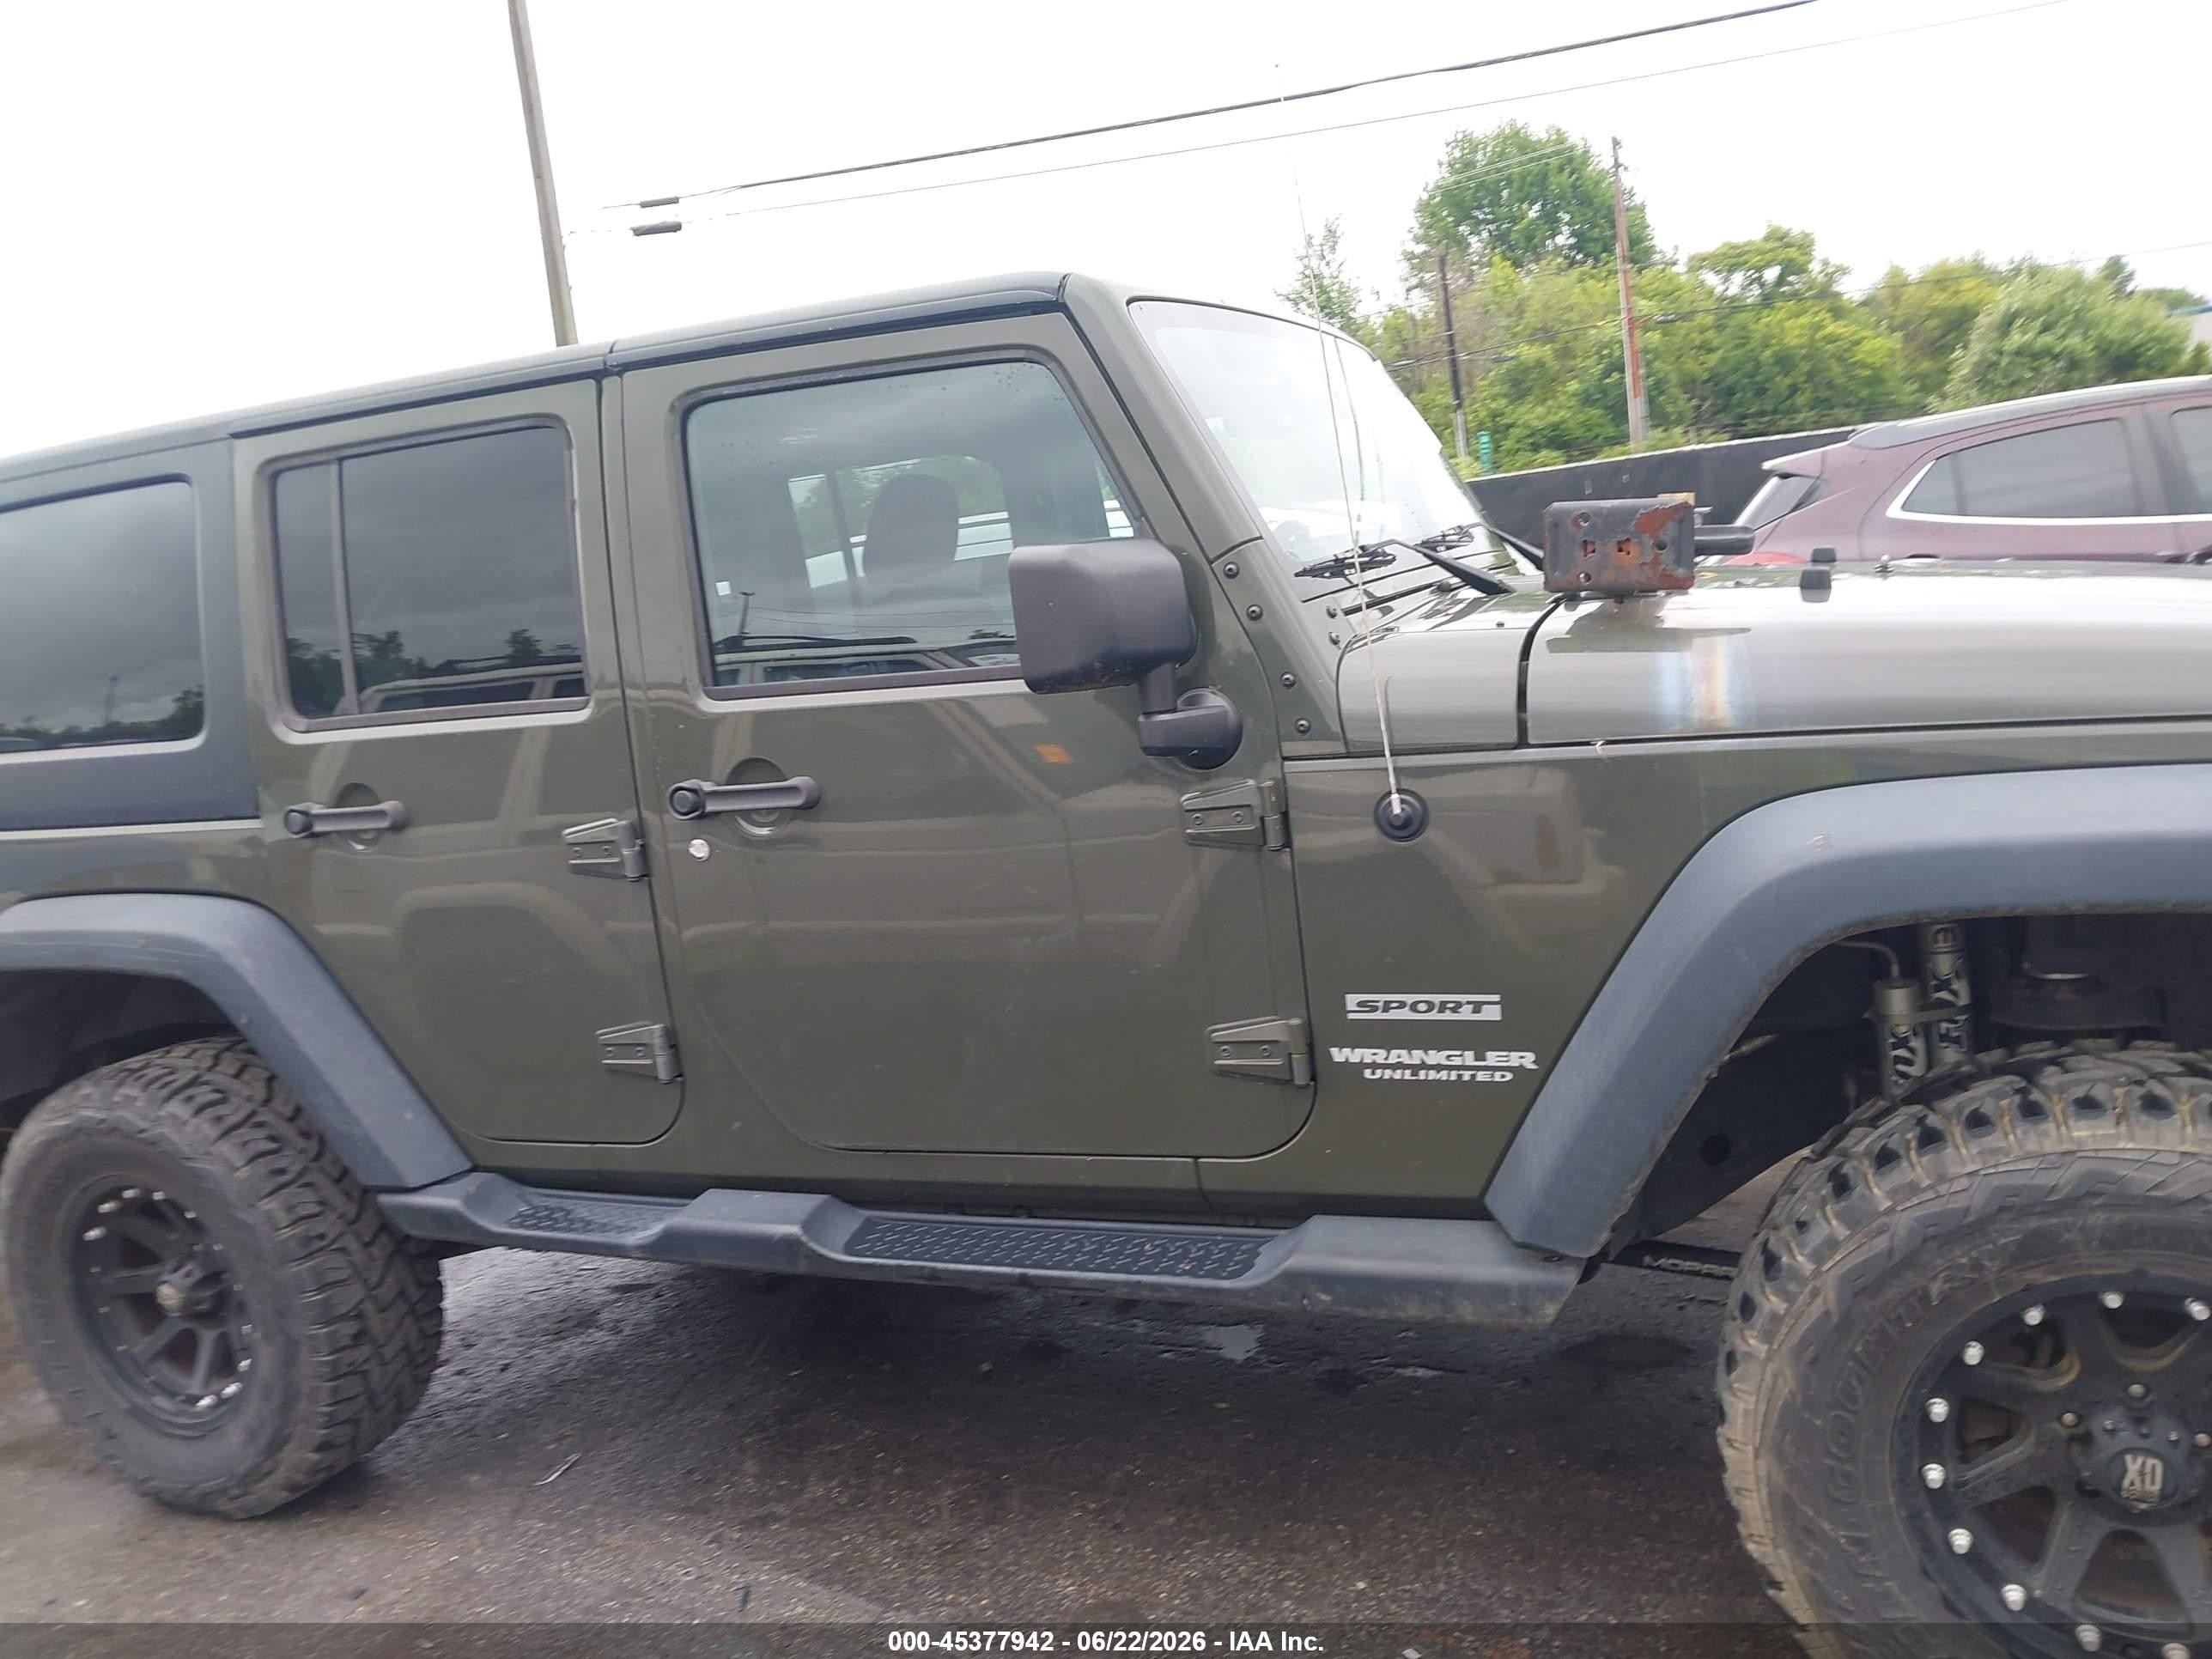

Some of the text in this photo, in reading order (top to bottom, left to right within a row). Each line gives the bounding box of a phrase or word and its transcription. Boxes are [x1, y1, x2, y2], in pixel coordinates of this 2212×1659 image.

[1348, 998, 1499, 1015] SPORT
[1329, 1048, 1539, 1069] WRANGLER
[1363, 1068, 1514, 1082] UNLIMITED
